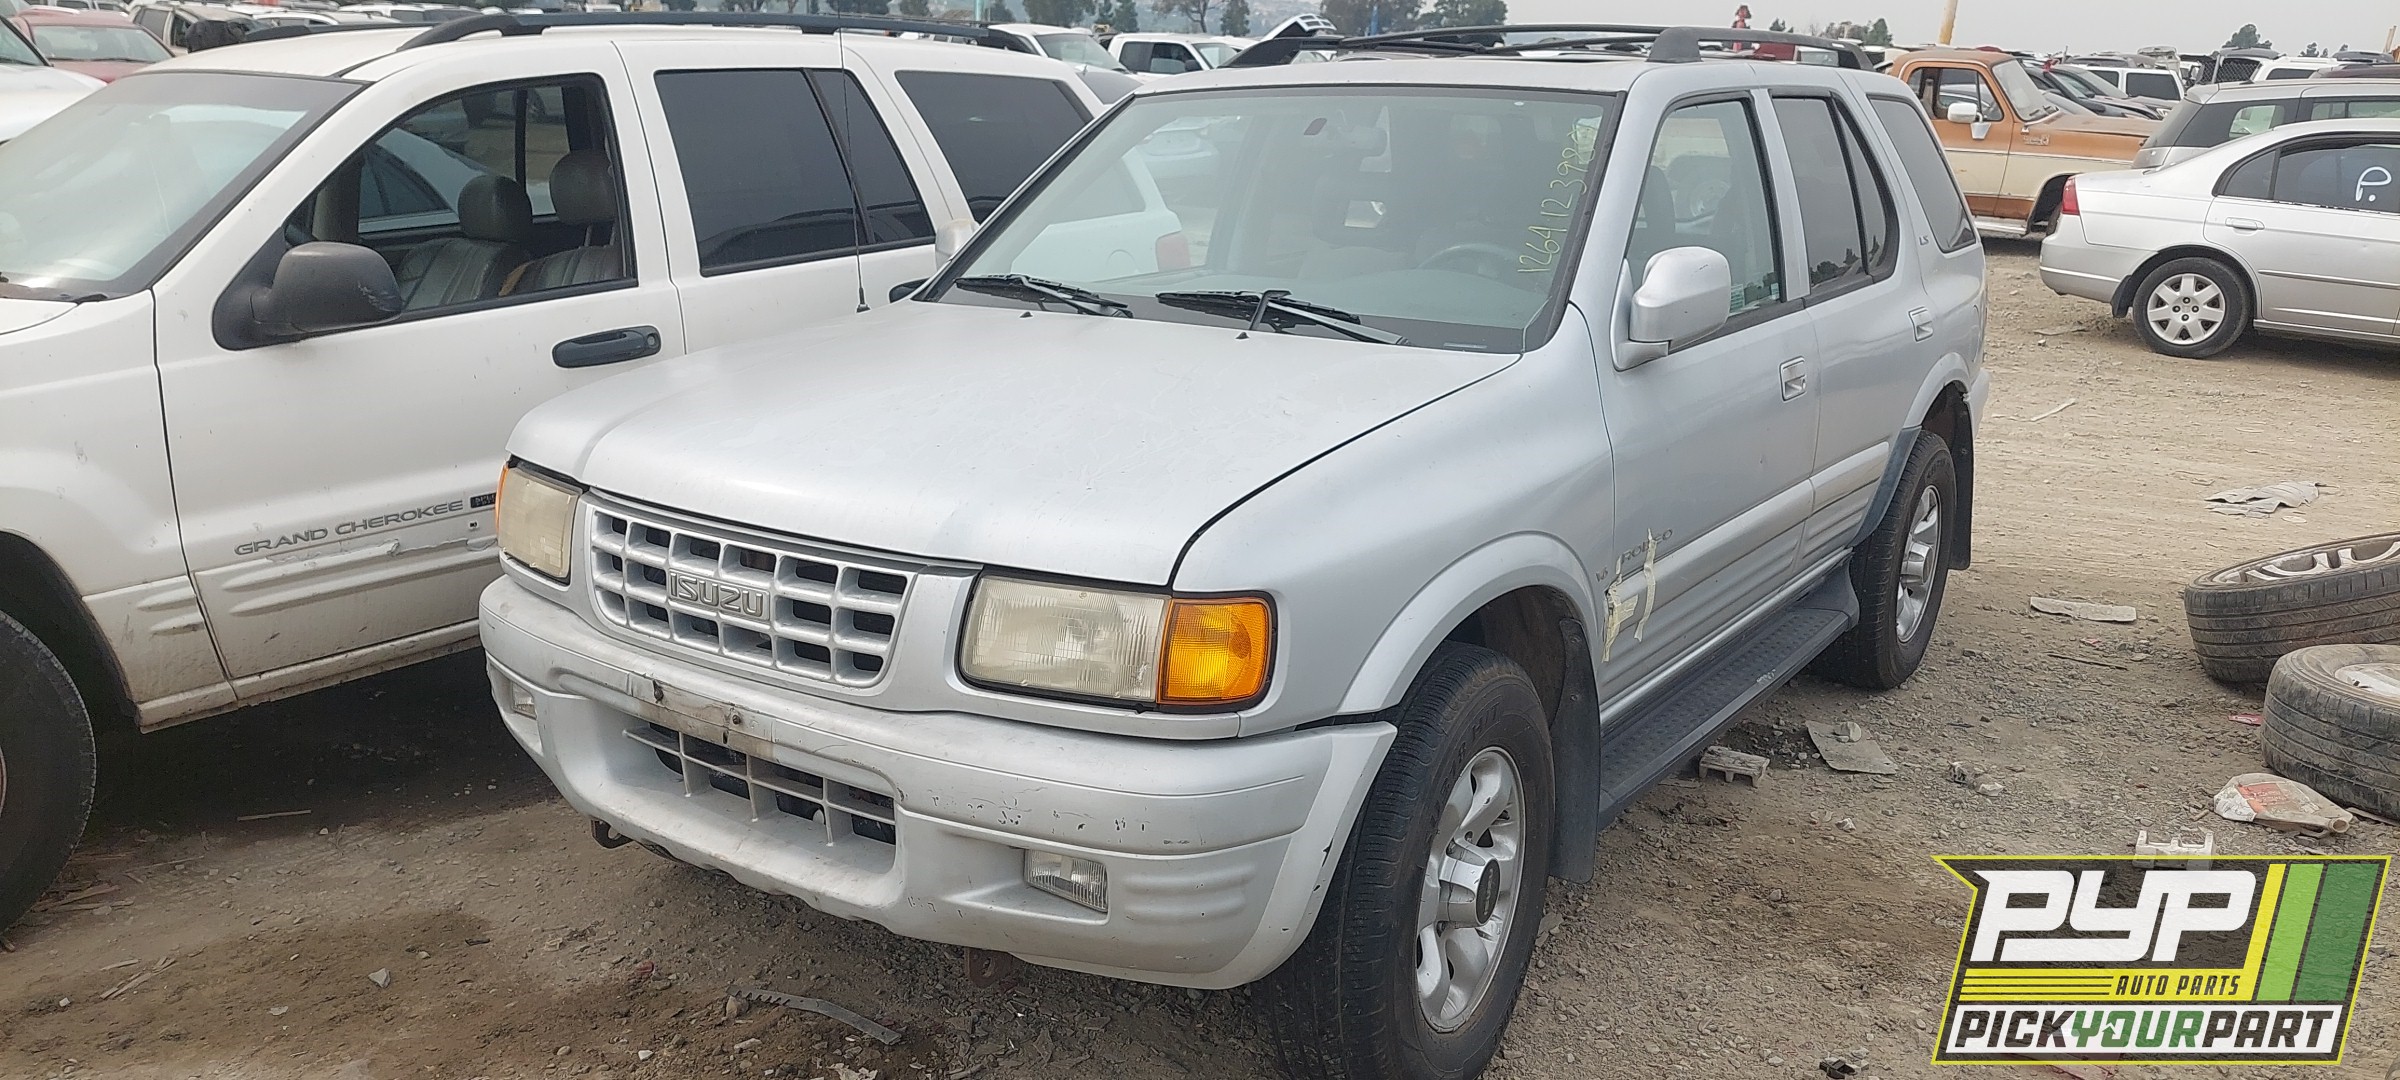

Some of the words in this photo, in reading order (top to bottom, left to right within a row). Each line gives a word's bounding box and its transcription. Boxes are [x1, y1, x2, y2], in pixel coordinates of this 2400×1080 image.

[234, 528, 328, 556] GRAND
[335, 500, 464, 536] CHEROKEE
[670, 573, 763, 617] ISUZU
